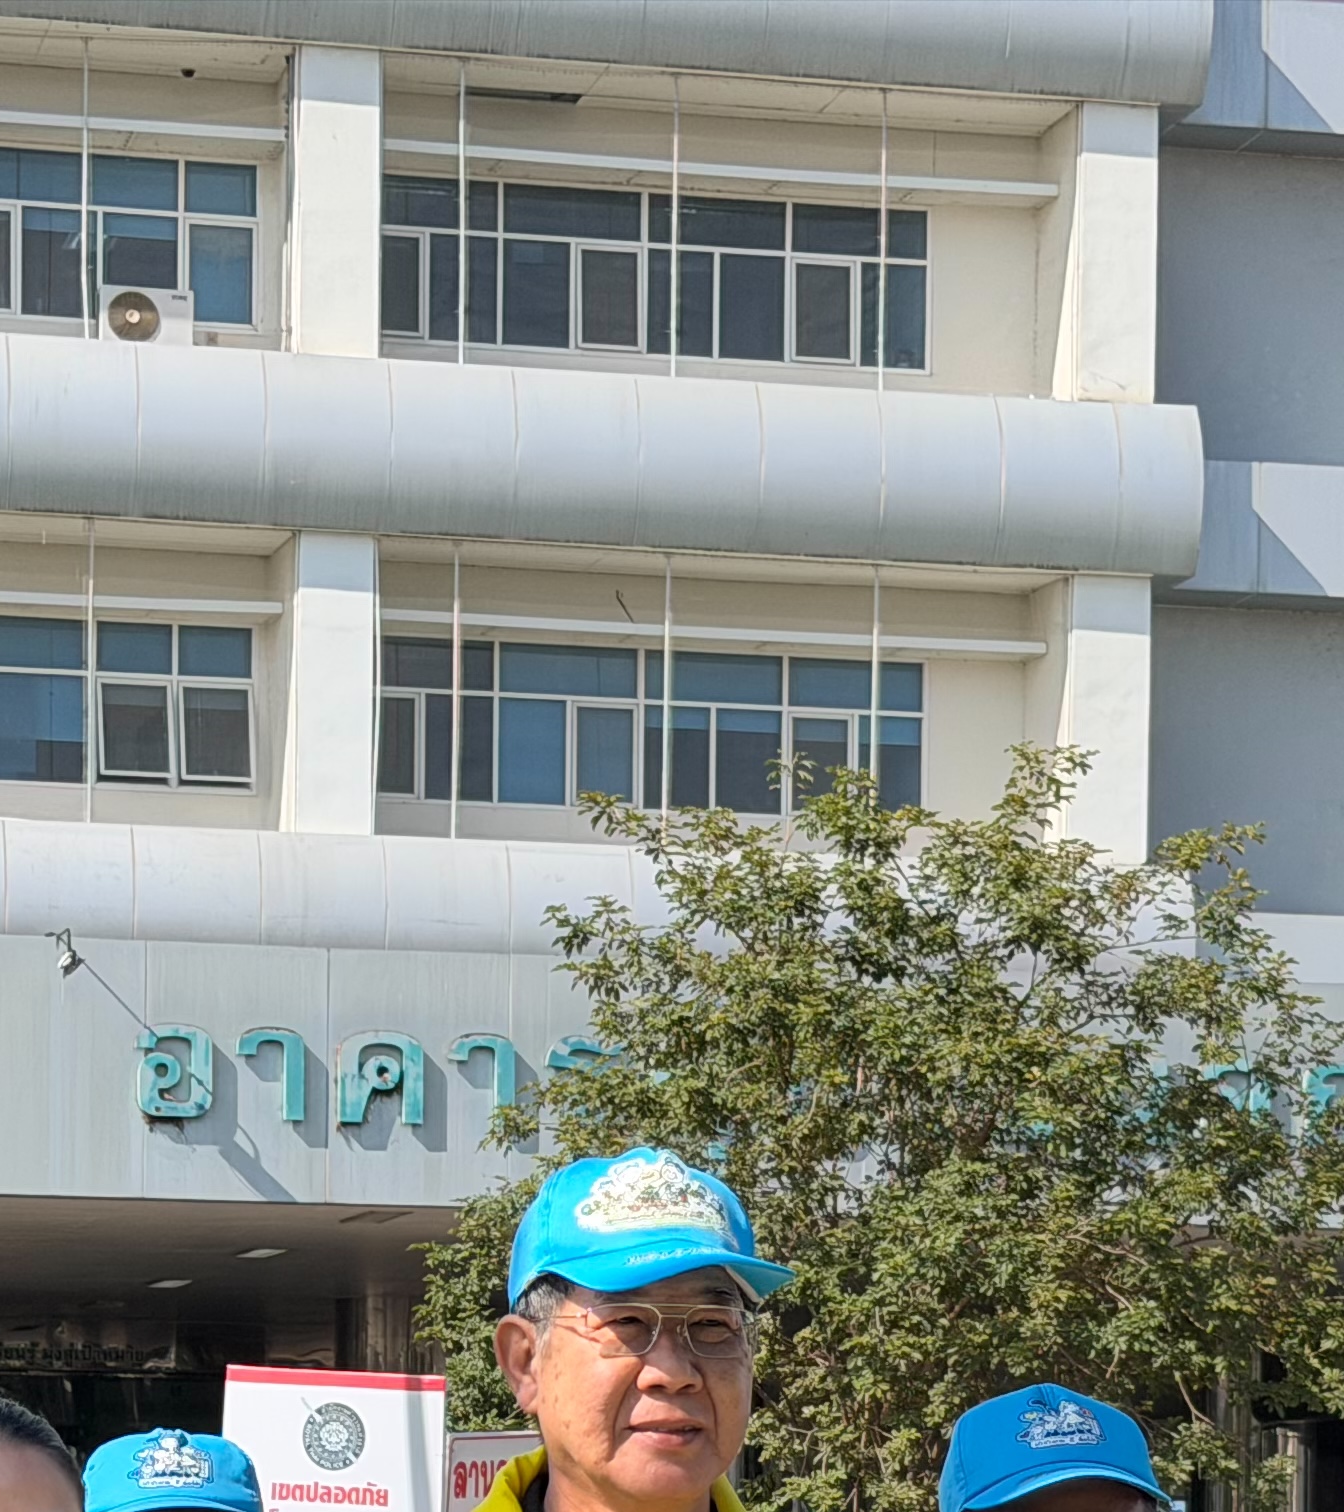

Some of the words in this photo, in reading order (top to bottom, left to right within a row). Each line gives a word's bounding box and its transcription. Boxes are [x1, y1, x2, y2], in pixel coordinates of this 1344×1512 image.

[271, 1481, 389, 1507] เขตปลอดภัย
[453, 1459, 509, 1499] ลาน
